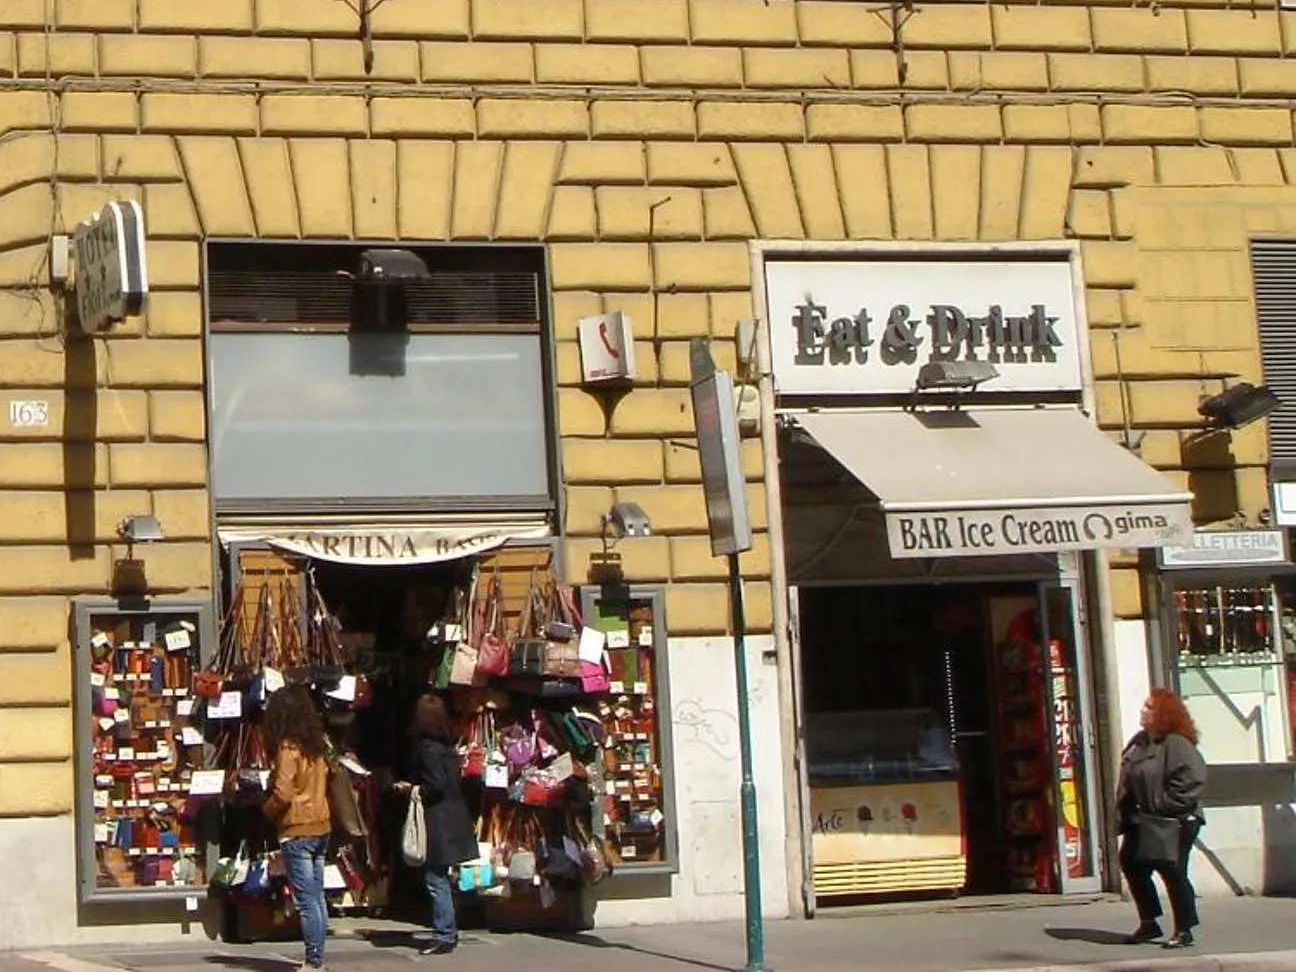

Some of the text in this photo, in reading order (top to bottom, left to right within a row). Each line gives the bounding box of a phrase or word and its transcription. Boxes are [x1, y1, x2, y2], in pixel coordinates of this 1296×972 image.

[795, 304, 1063, 349] Eat & Drink
[12, 402, 48, 424] 163
[287, 533, 418, 559] ARTINA
[899, 518, 953, 551] BAR
[957, 516, 996, 548] Ice
[1000, 514, 1081, 546] Cream
[1114, 511, 1169, 534] gima
